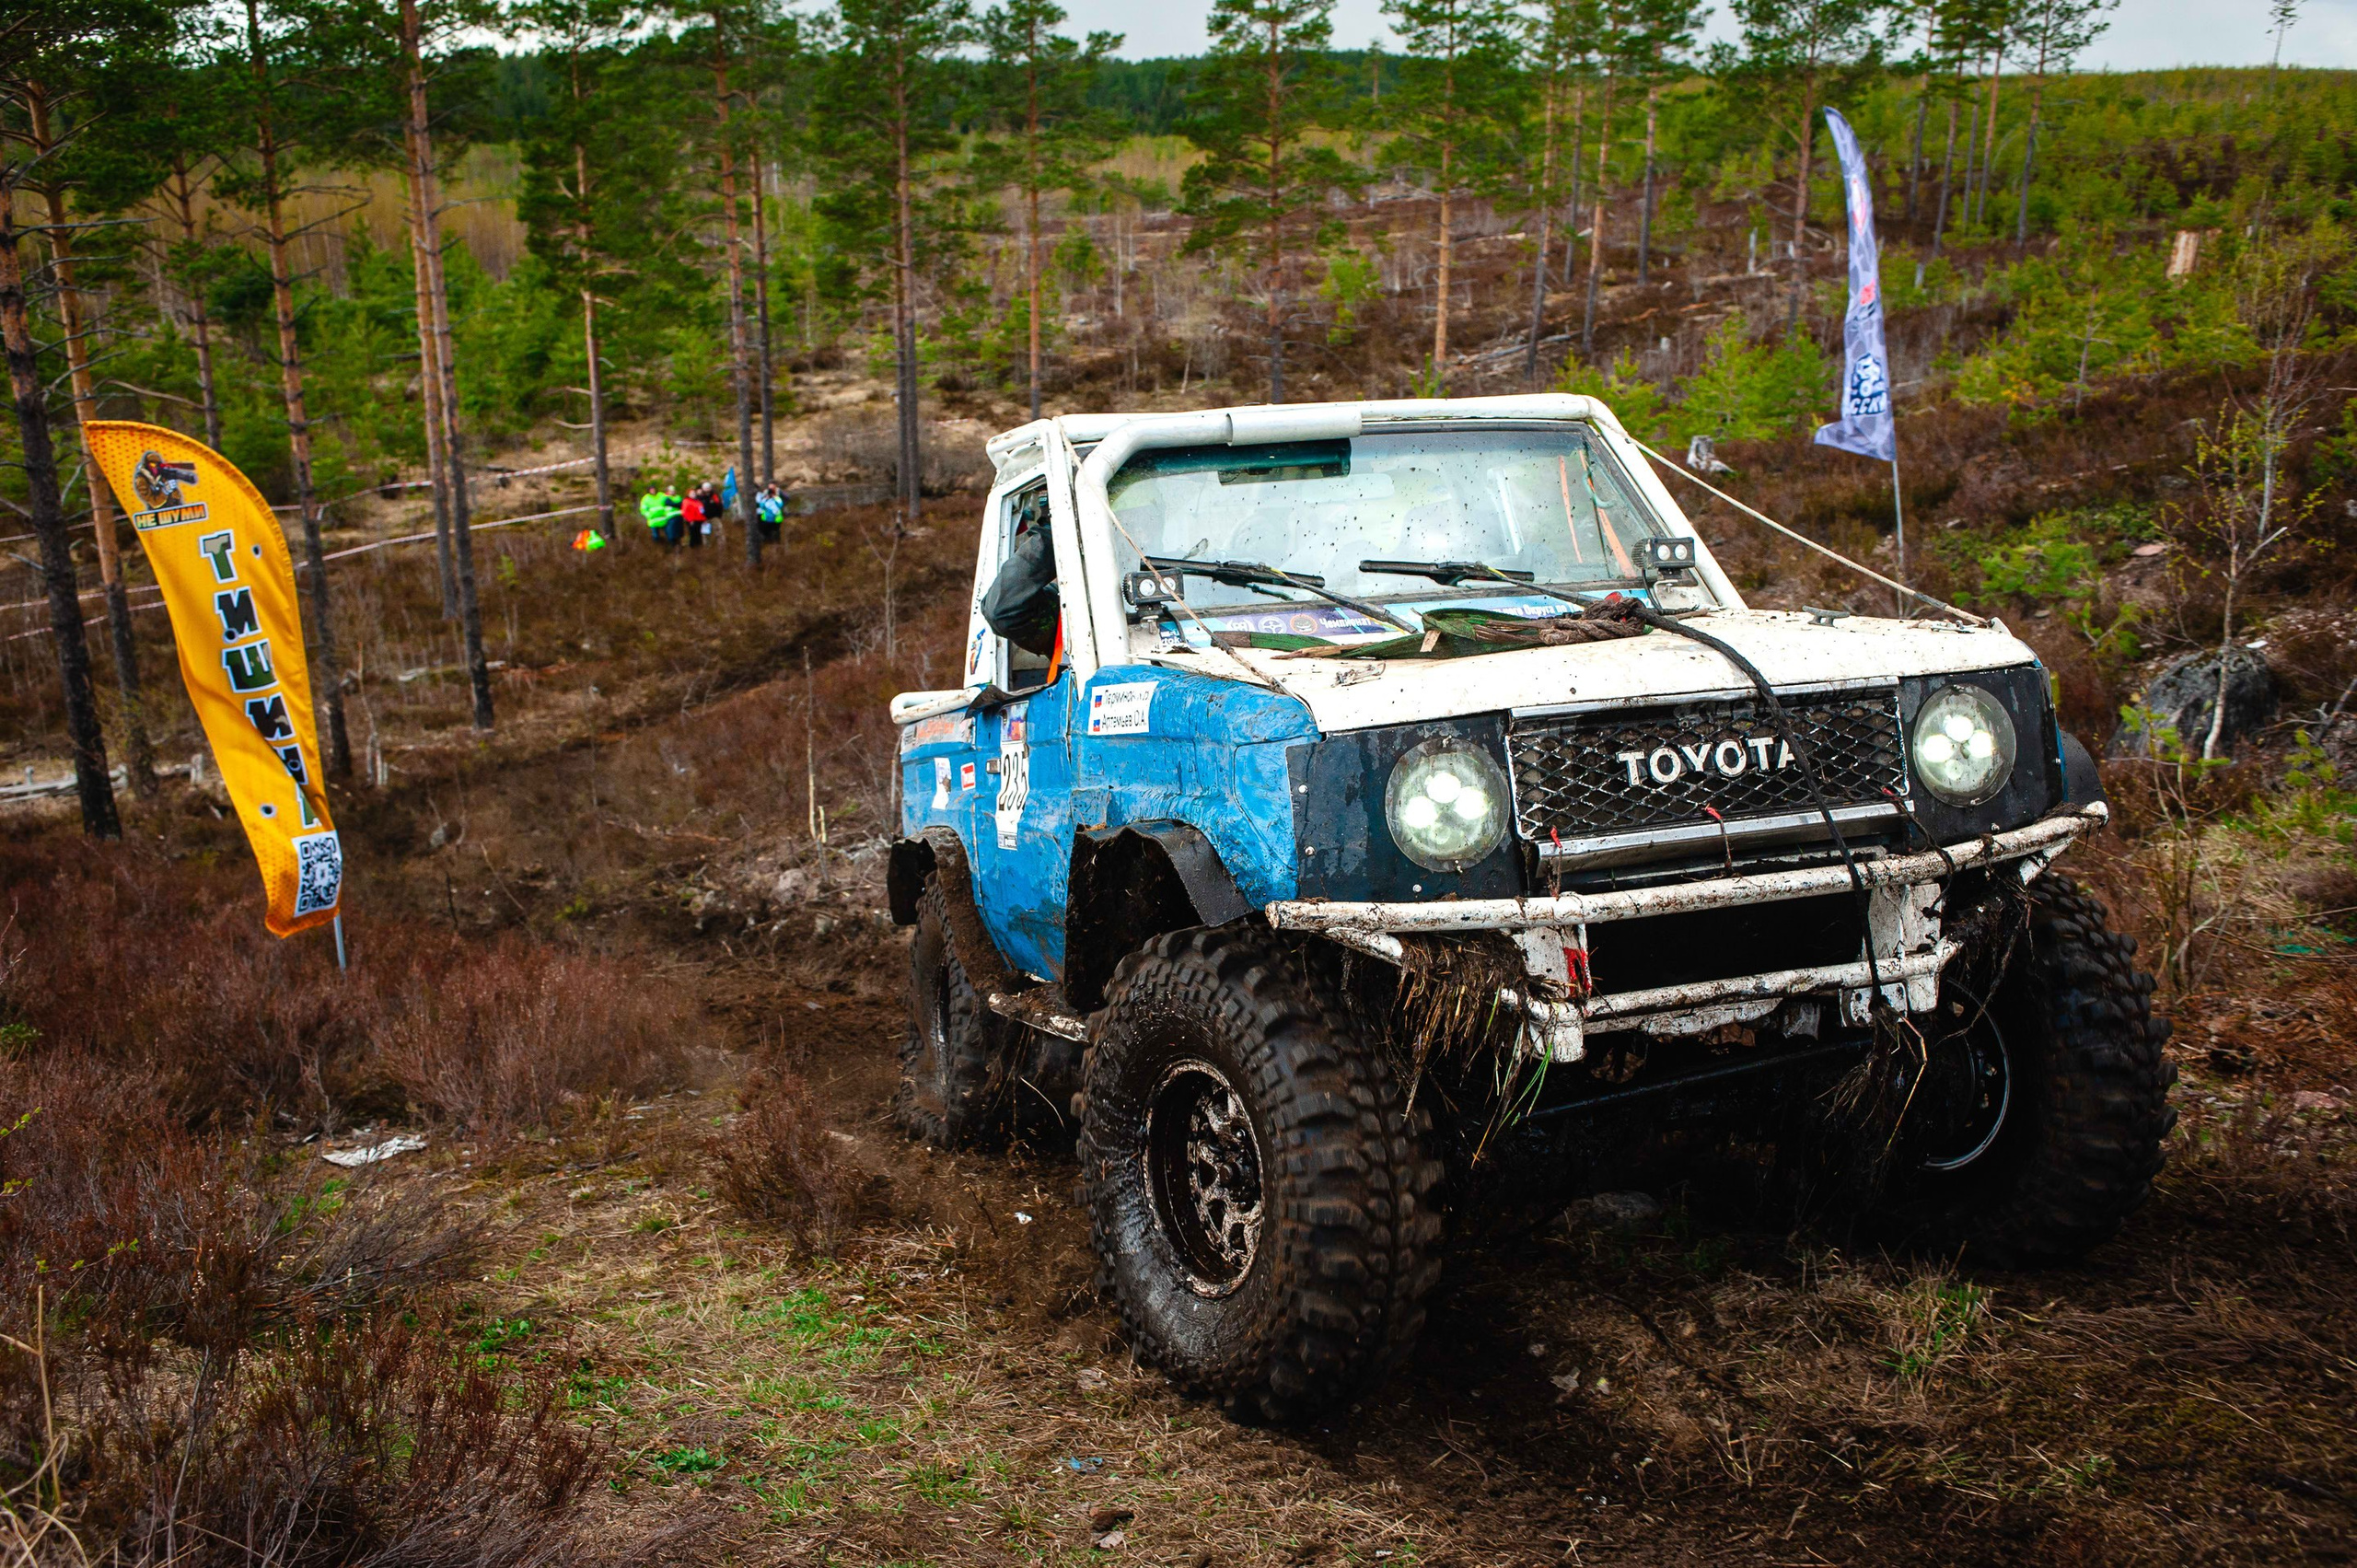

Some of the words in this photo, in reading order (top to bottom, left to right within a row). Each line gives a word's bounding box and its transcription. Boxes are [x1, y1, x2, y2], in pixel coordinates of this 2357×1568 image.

[135, 513, 157, 528] НЕ
[157, 505, 205, 525] ШУМИ
[1522, 604, 1555, 616] Округа
[1319, 618, 1371, 628] Чемпионат
[1102, 714, 1132, 732] Артемьев
[1616, 737, 1795, 787] TOYOTA
